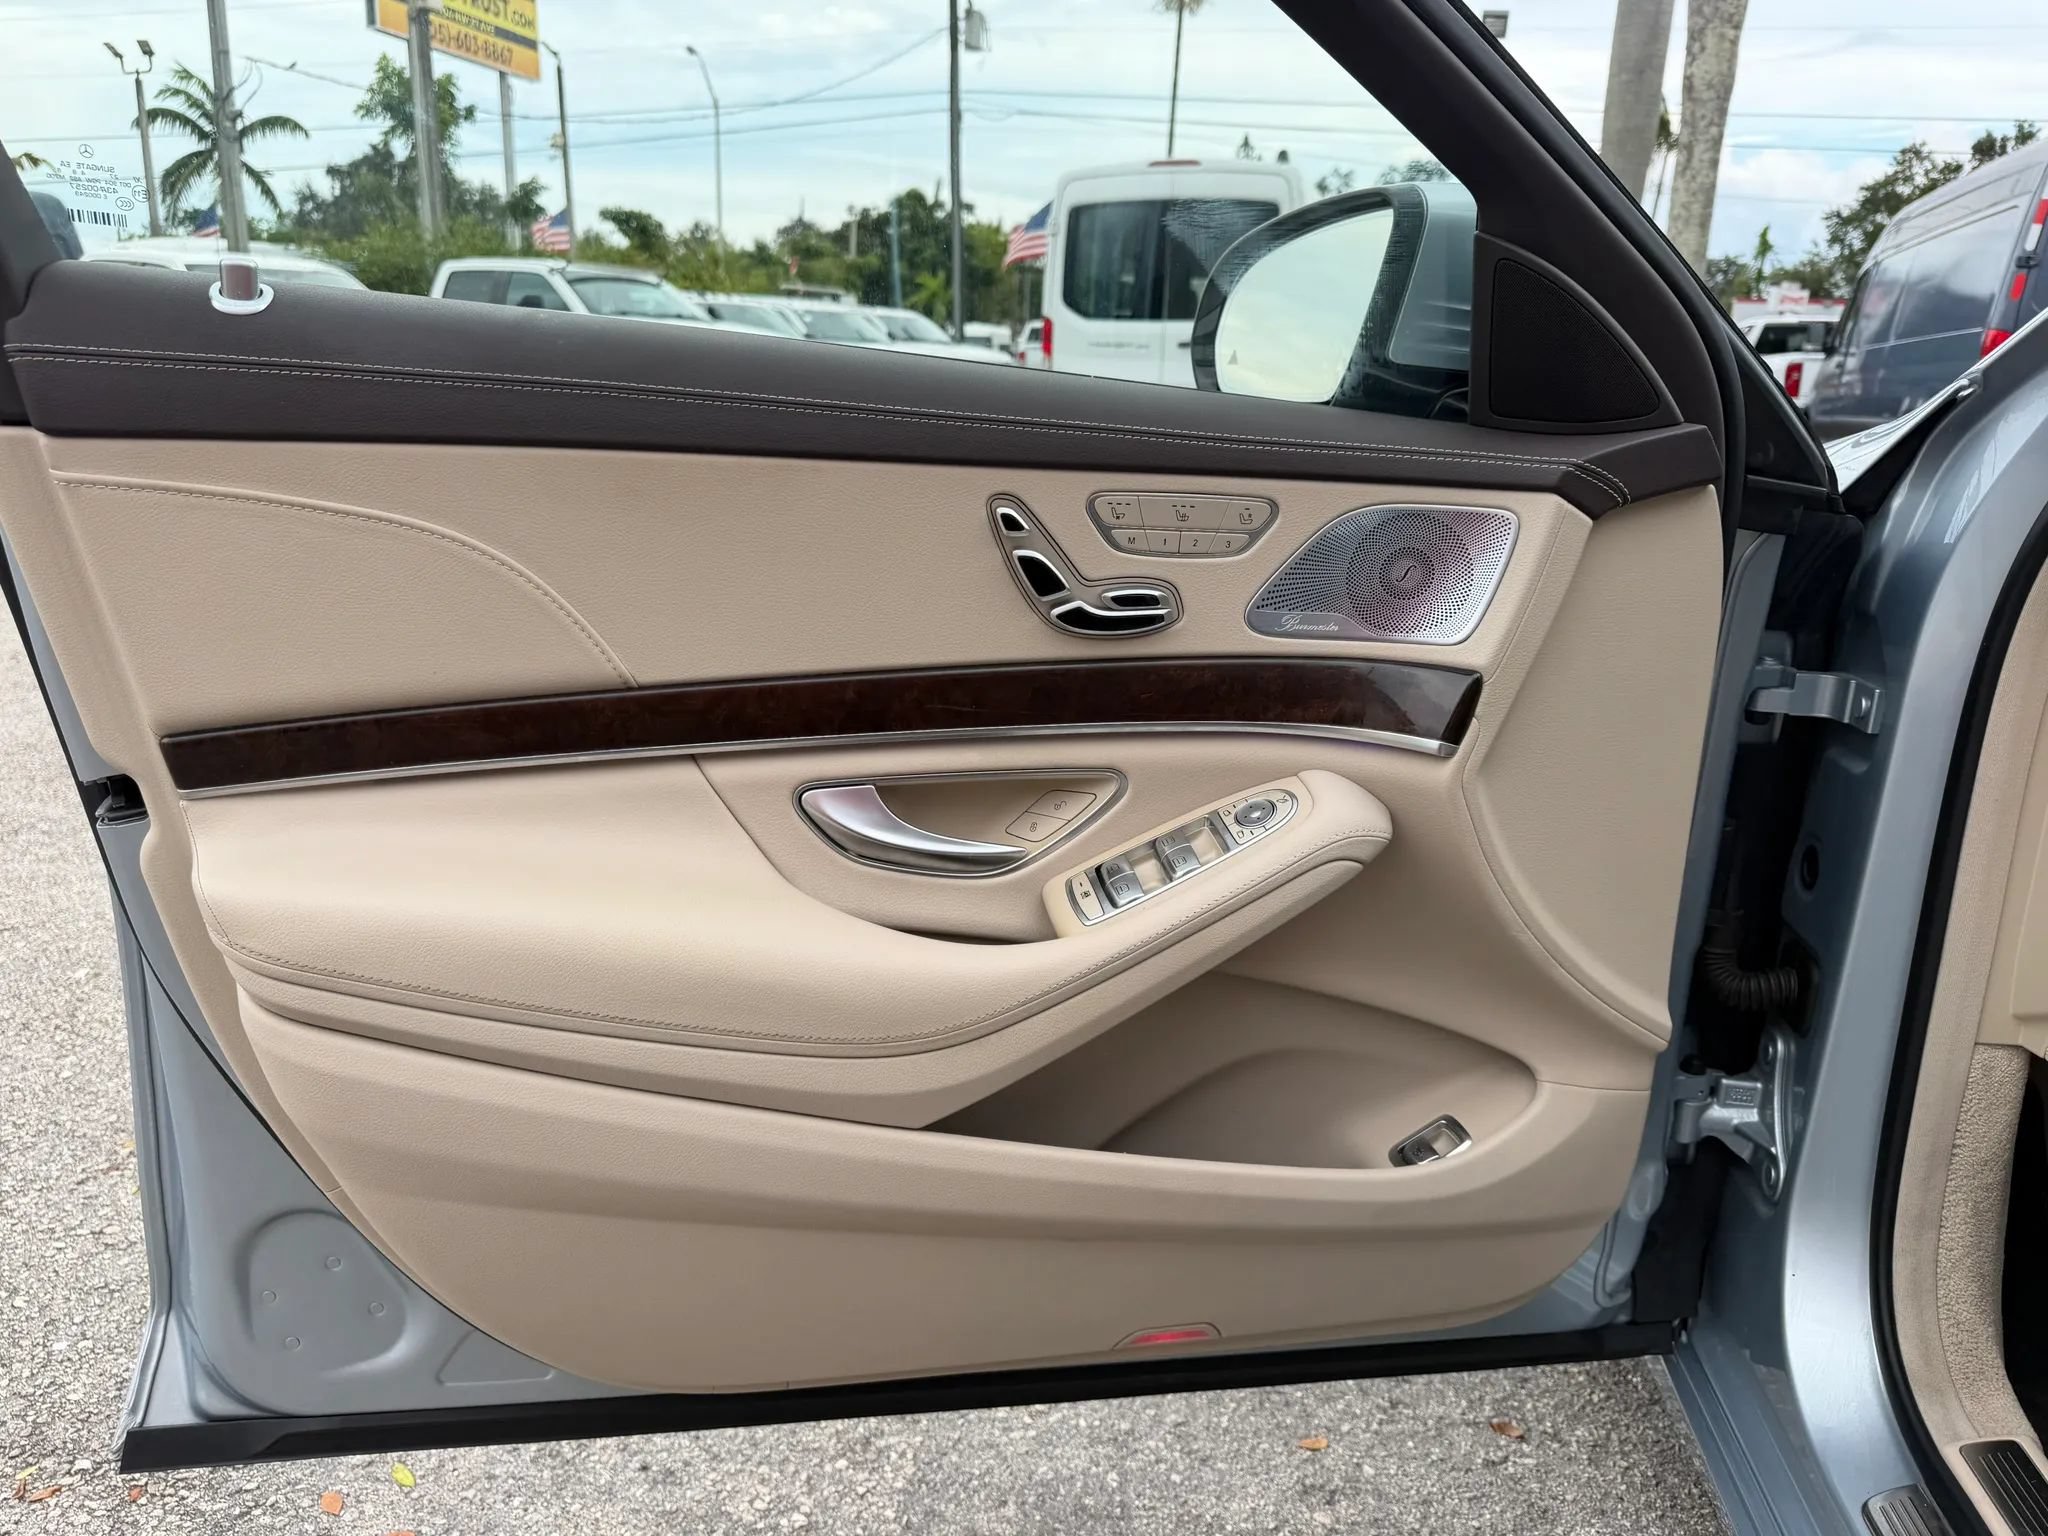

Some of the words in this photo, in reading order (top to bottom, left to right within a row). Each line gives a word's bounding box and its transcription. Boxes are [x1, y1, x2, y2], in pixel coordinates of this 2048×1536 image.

[1127, 536, 1136, 545] M
[1192, 538, 1199, 547] 2
[1225, 540, 1232, 549] 3
